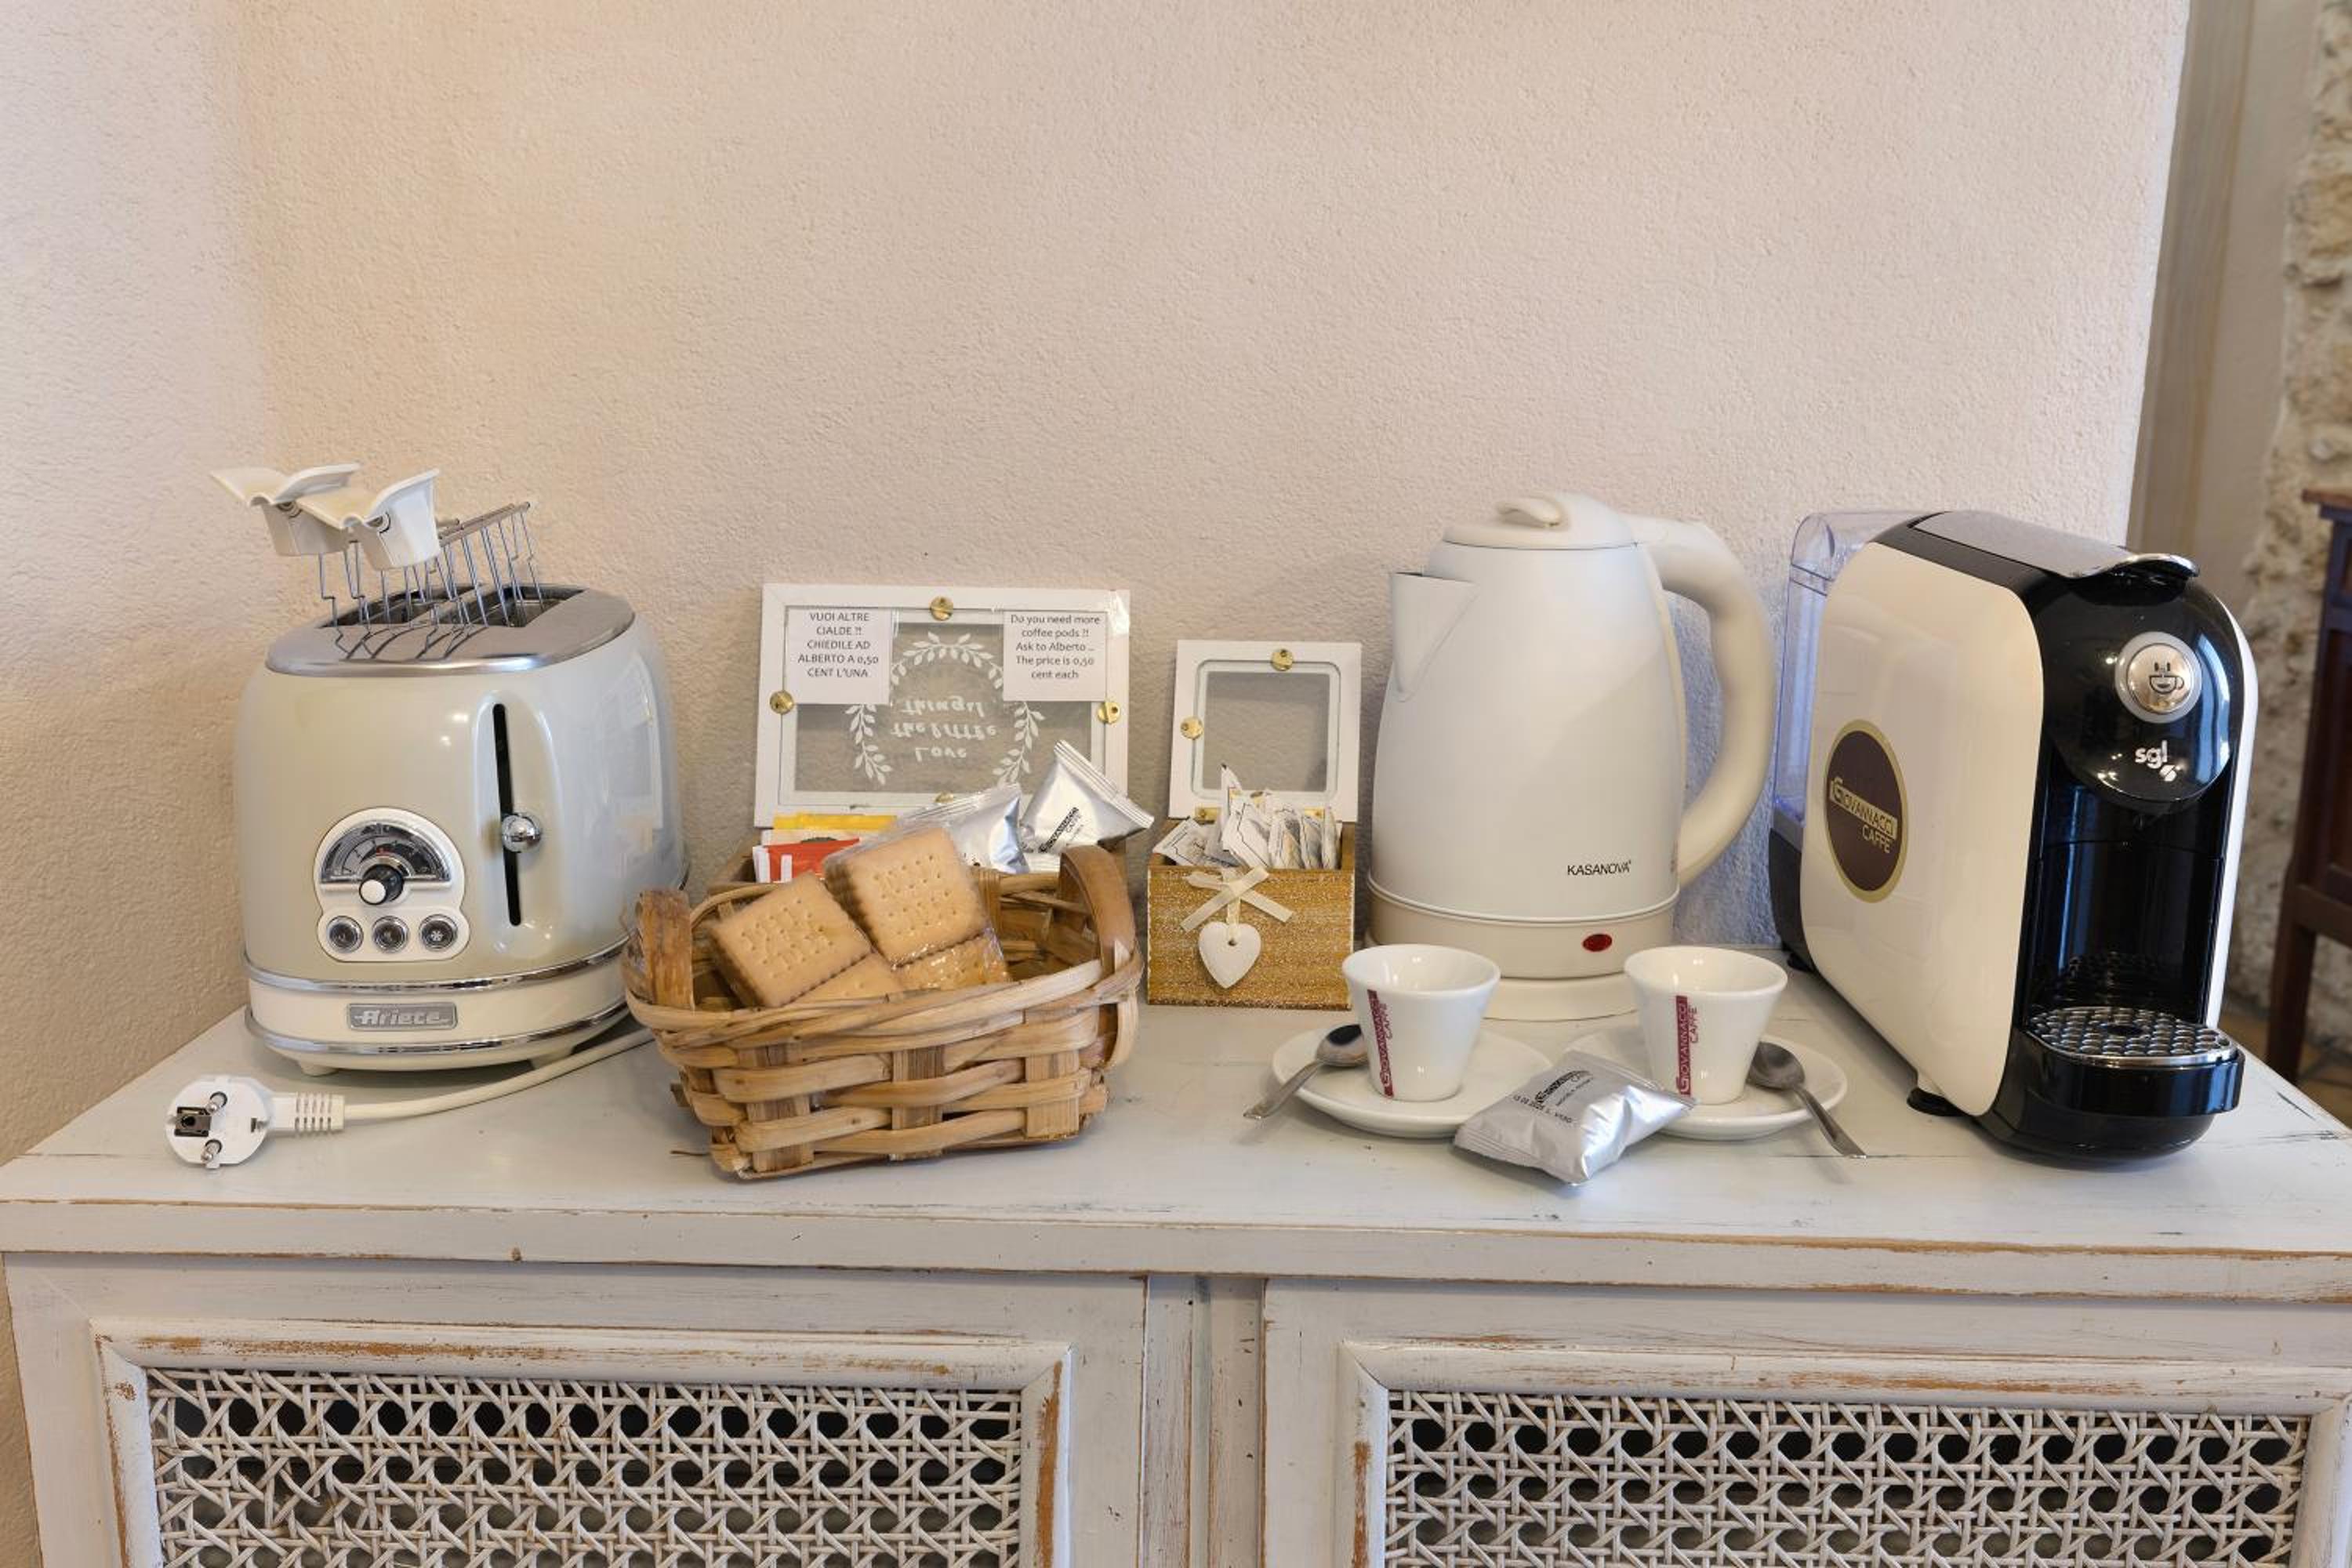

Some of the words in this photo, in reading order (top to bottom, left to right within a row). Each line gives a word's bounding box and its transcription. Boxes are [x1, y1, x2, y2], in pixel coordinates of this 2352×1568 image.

[809, 612, 835, 622] VUOI
[837, 612, 870, 622] ALTRE
[1010, 614, 1024, 624] Do
[1026, 616, 1045, 626] you
[1047, 614, 1072, 624] need
[1073, 616, 1101, 625] more
[816, 626, 852, 636] CIALDE
[1021, 627, 1053, 637] coffee
[1054, 628, 1080, 639] pods
[806, 640, 854, 650] CHIEDILE
[855, 641, 872, 650] AD
[1015, 641, 1034, 652] Ask
[1035, 642, 1047, 652] to
[1048, 641, 1086, 652] Alberto
[797, 654, 846, 664] ALBERTO
[847, 654, 855, 664] A
[857, 656, 879, 666] 0,50
[1015, 655, 1034, 666] The
[1035, 656, 1061, 667] price
[1062, 656, 1070, 666] is
[807, 667, 833, 677] CENT
[837, 668, 869, 678] L'UNA
[1031, 670, 1052, 680] cent
[1054, 670, 1080, 679] each
[2134, 739, 2168, 769] sgl
[1567, 862, 1630, 876] KASANOVA
[357, 1009, 445, 1025] Ariete
